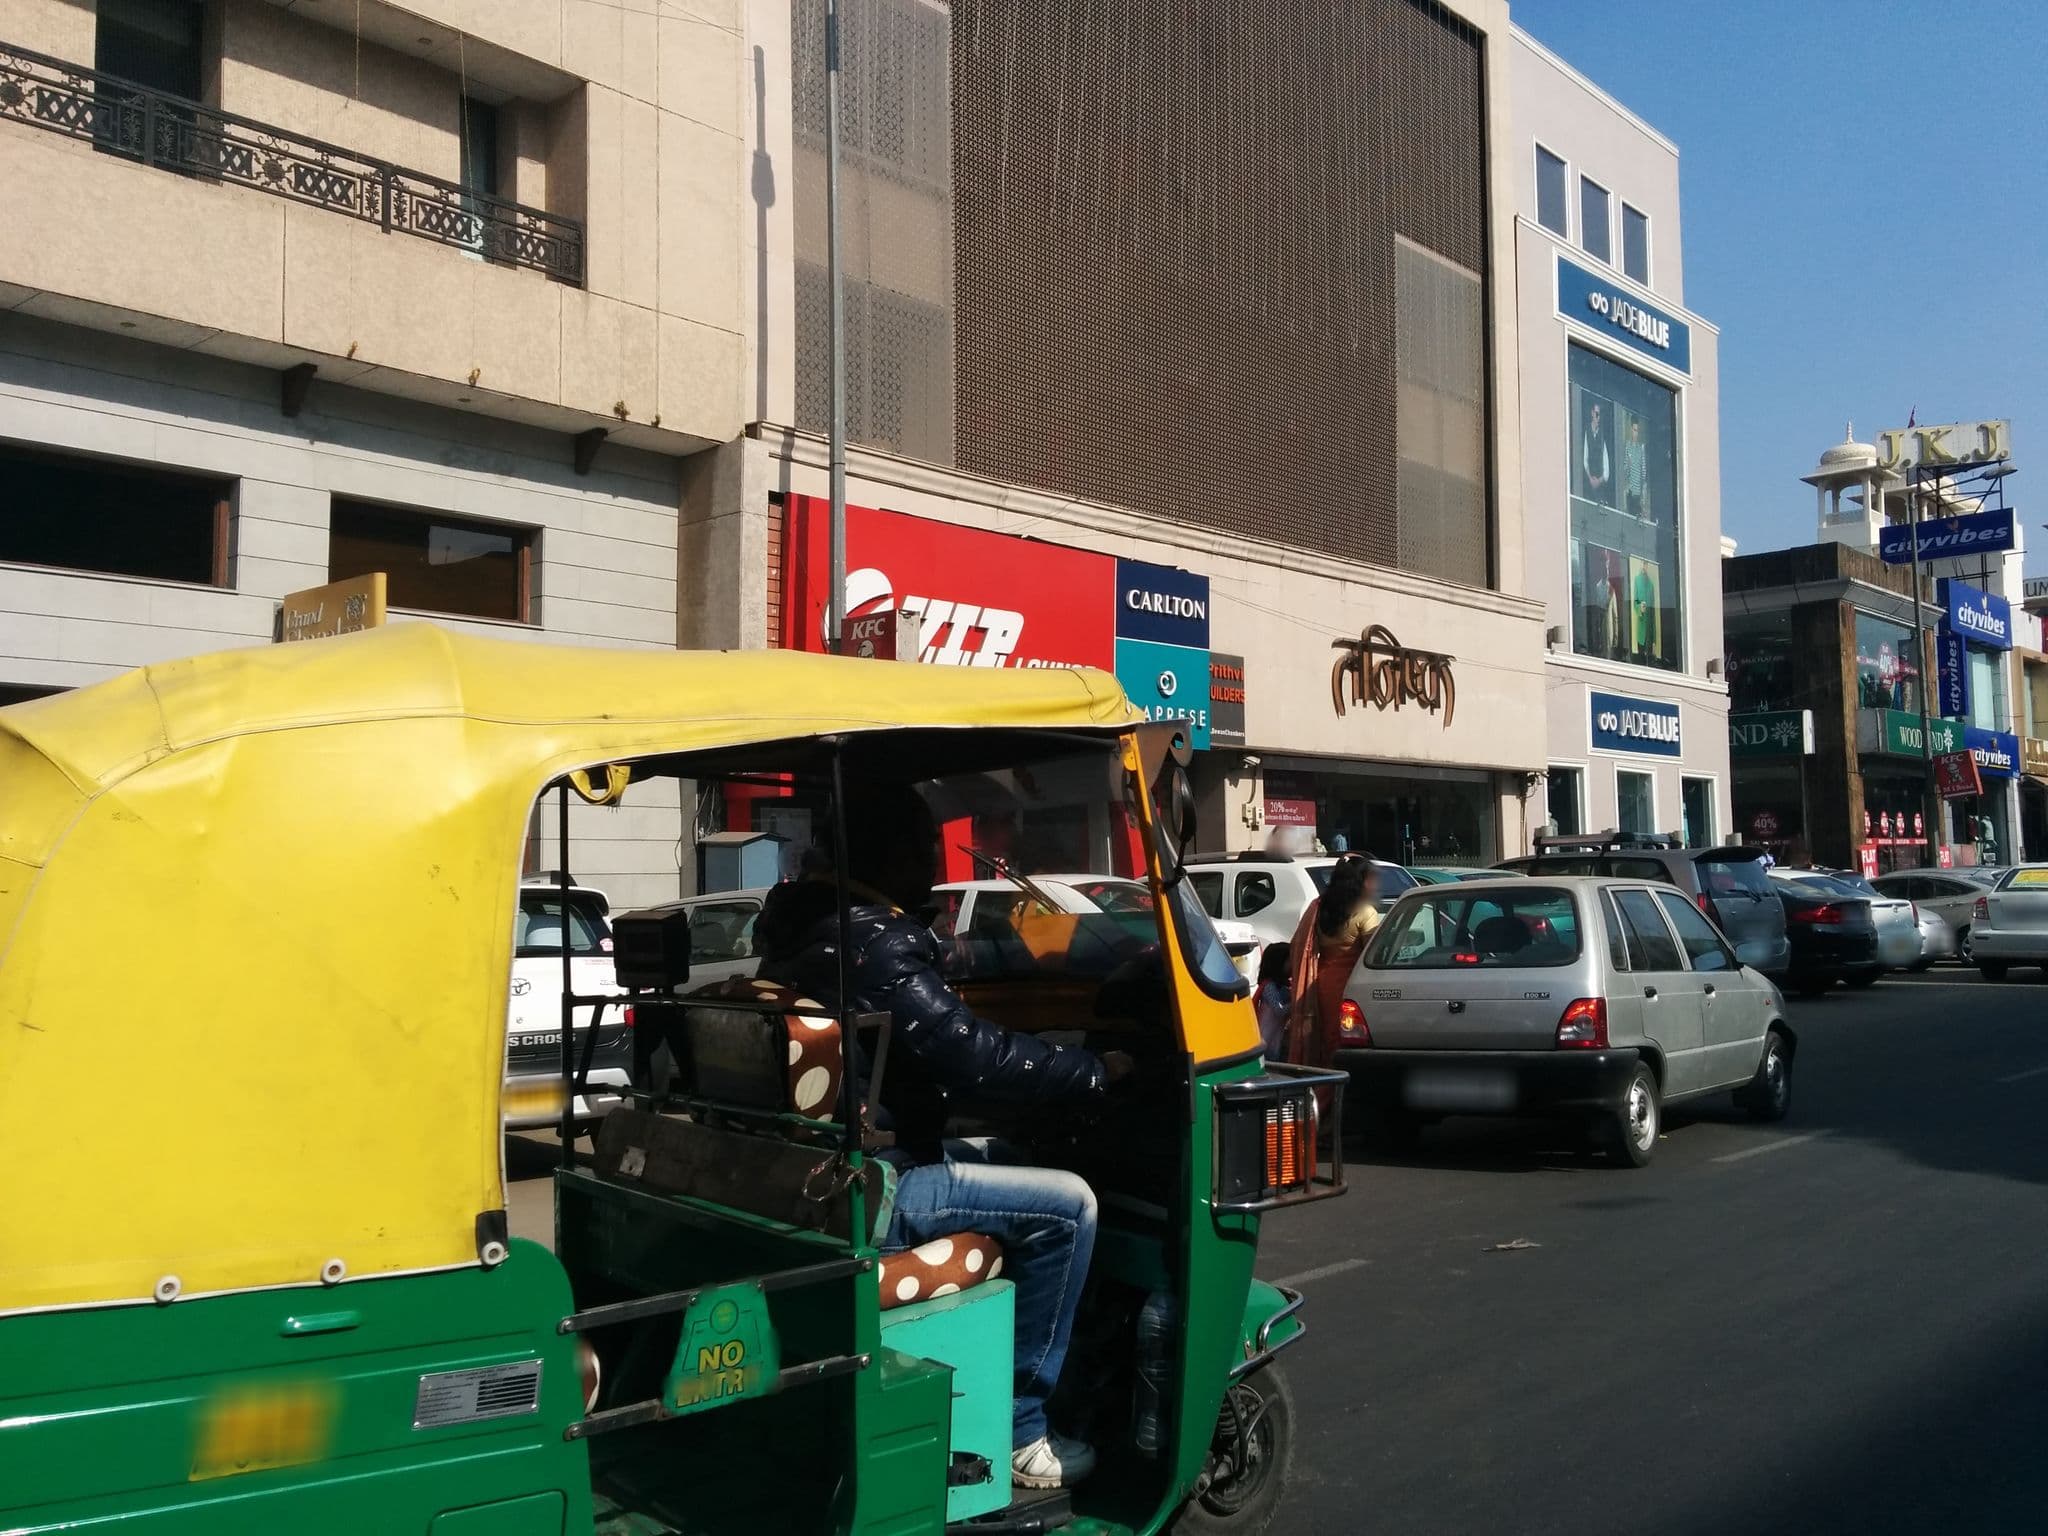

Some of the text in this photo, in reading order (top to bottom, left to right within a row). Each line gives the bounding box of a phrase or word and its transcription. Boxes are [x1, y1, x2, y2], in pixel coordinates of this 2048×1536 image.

[1611, 296, 1670, 349] JADEBLUE
[1127, 589, 1206, 620] CARLTON
[851, 617, 887, 642] KFC
[1957, 601, 2006, 635] cityvibes
[1947, 639, 1962, 712] cityvibes
[1210, 685, 1246, 703] UILDERS
[1144, 704, 1207, 727] APRESE
[1619, 710, 1680, 742] JADEBLUE
[1729, 724, 1769, 746] ND
[1899, 726, 1944, 751] WOODND
[1941, 753, 1964, 764] KFC
[1974, 749, 2012, 766] cityvibes
[521, 1033, 577, 1047] CROS
[698, 1339, 745, 1374] NO
